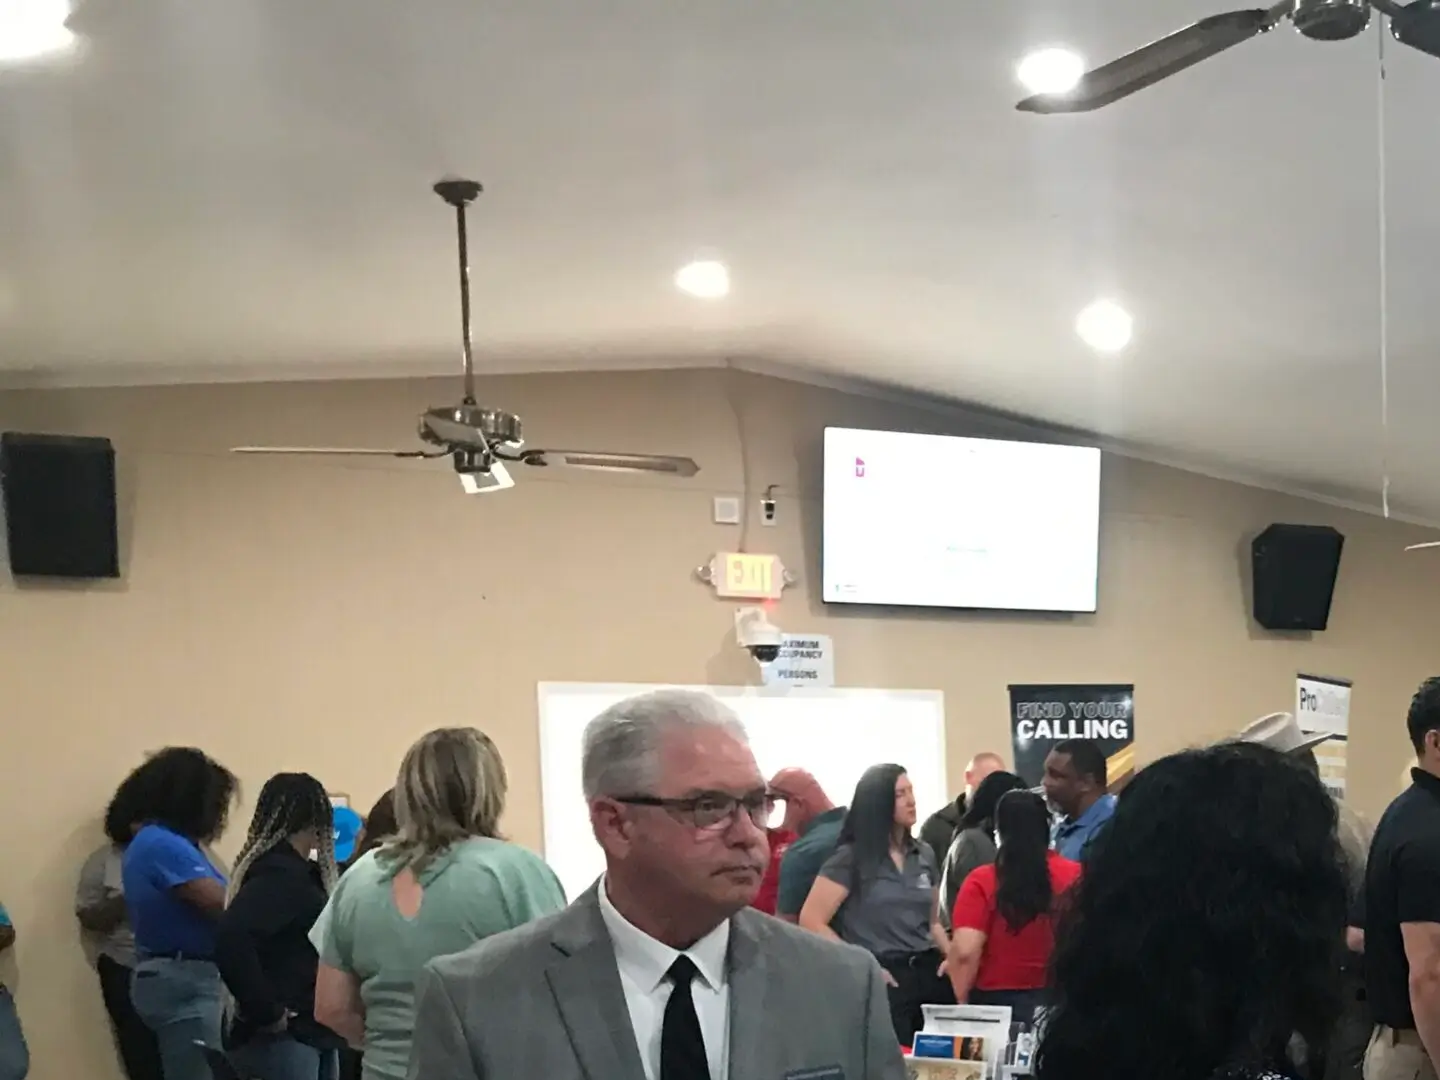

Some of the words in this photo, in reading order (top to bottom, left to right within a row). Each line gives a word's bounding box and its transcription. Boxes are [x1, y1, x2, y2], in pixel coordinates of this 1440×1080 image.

[781, 640, 820, 649] AXIMUM
[778, 669, 819, 679] PERSONS
[1016, 701, 1066, 719] FIND
[1068, 701, 1128, 719] YOUR
[1016, 719, 1129, 740] CALLING
